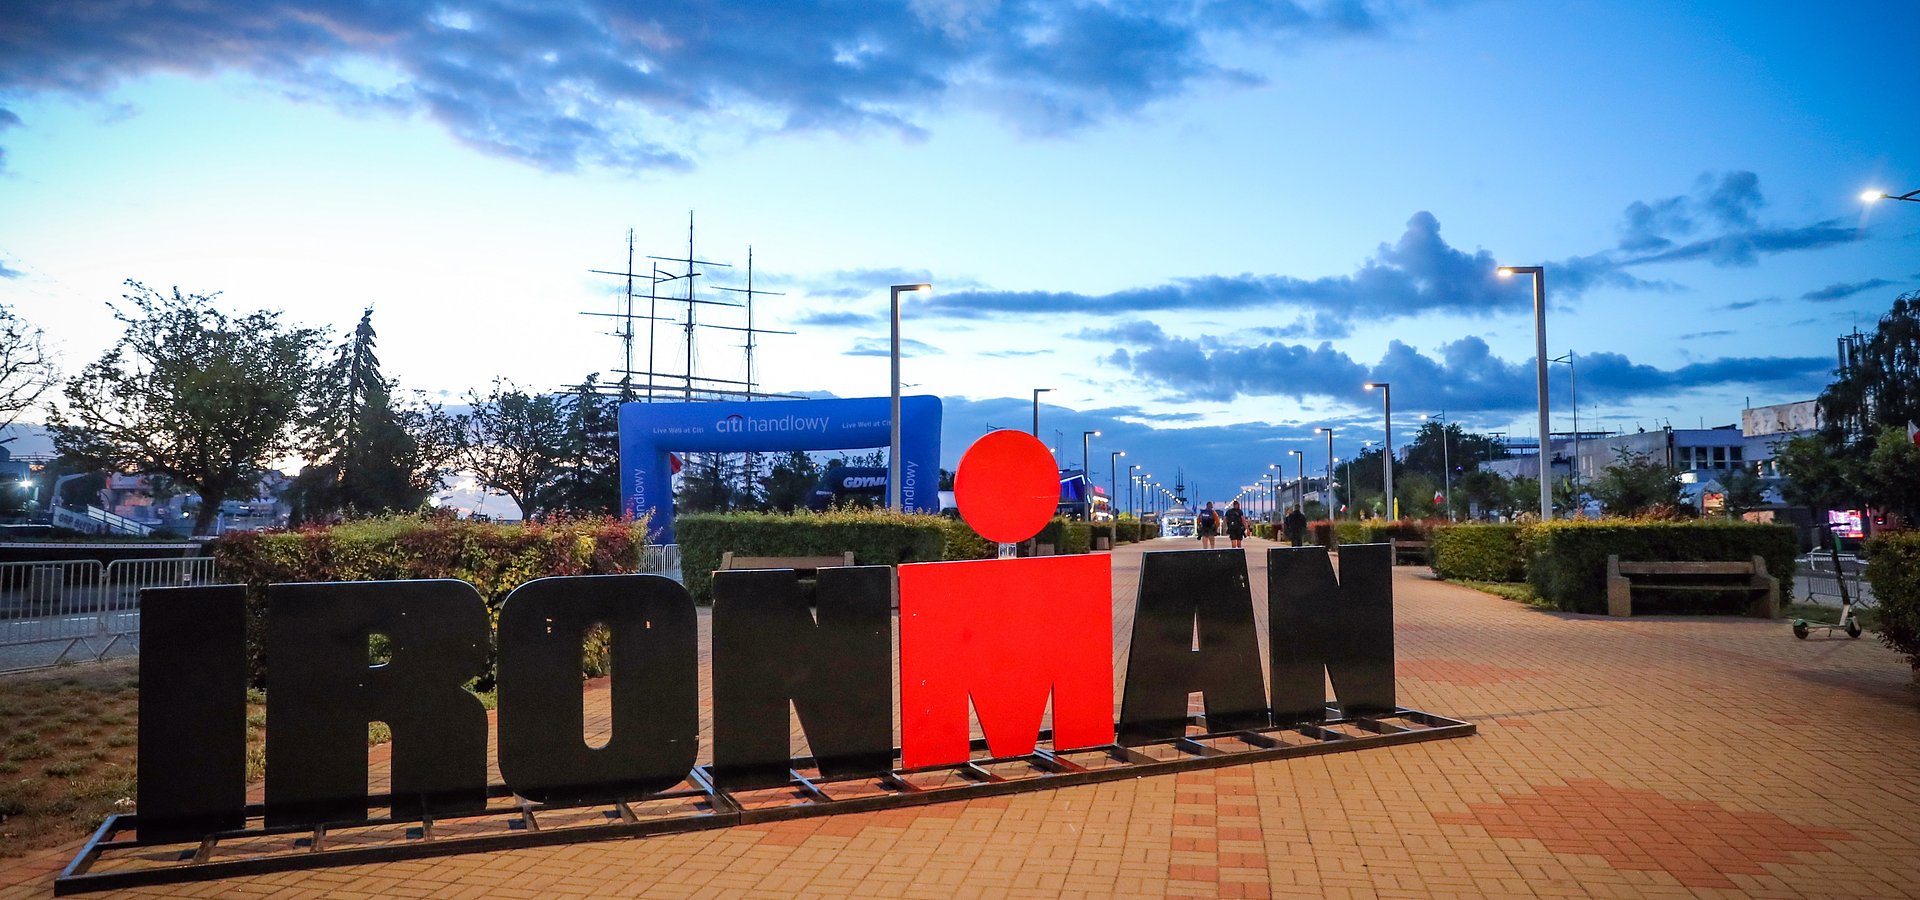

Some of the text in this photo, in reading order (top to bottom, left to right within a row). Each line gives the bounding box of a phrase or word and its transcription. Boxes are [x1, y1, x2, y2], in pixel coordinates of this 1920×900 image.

[716, 414, 829, 433] citi handlowy
[842, 421, 856, 429] Live
[633, 468, 646, 519] andlowy
[903, 460, 919, 514] andlowy
[137, 543, 1396, 844] IRONMAN
